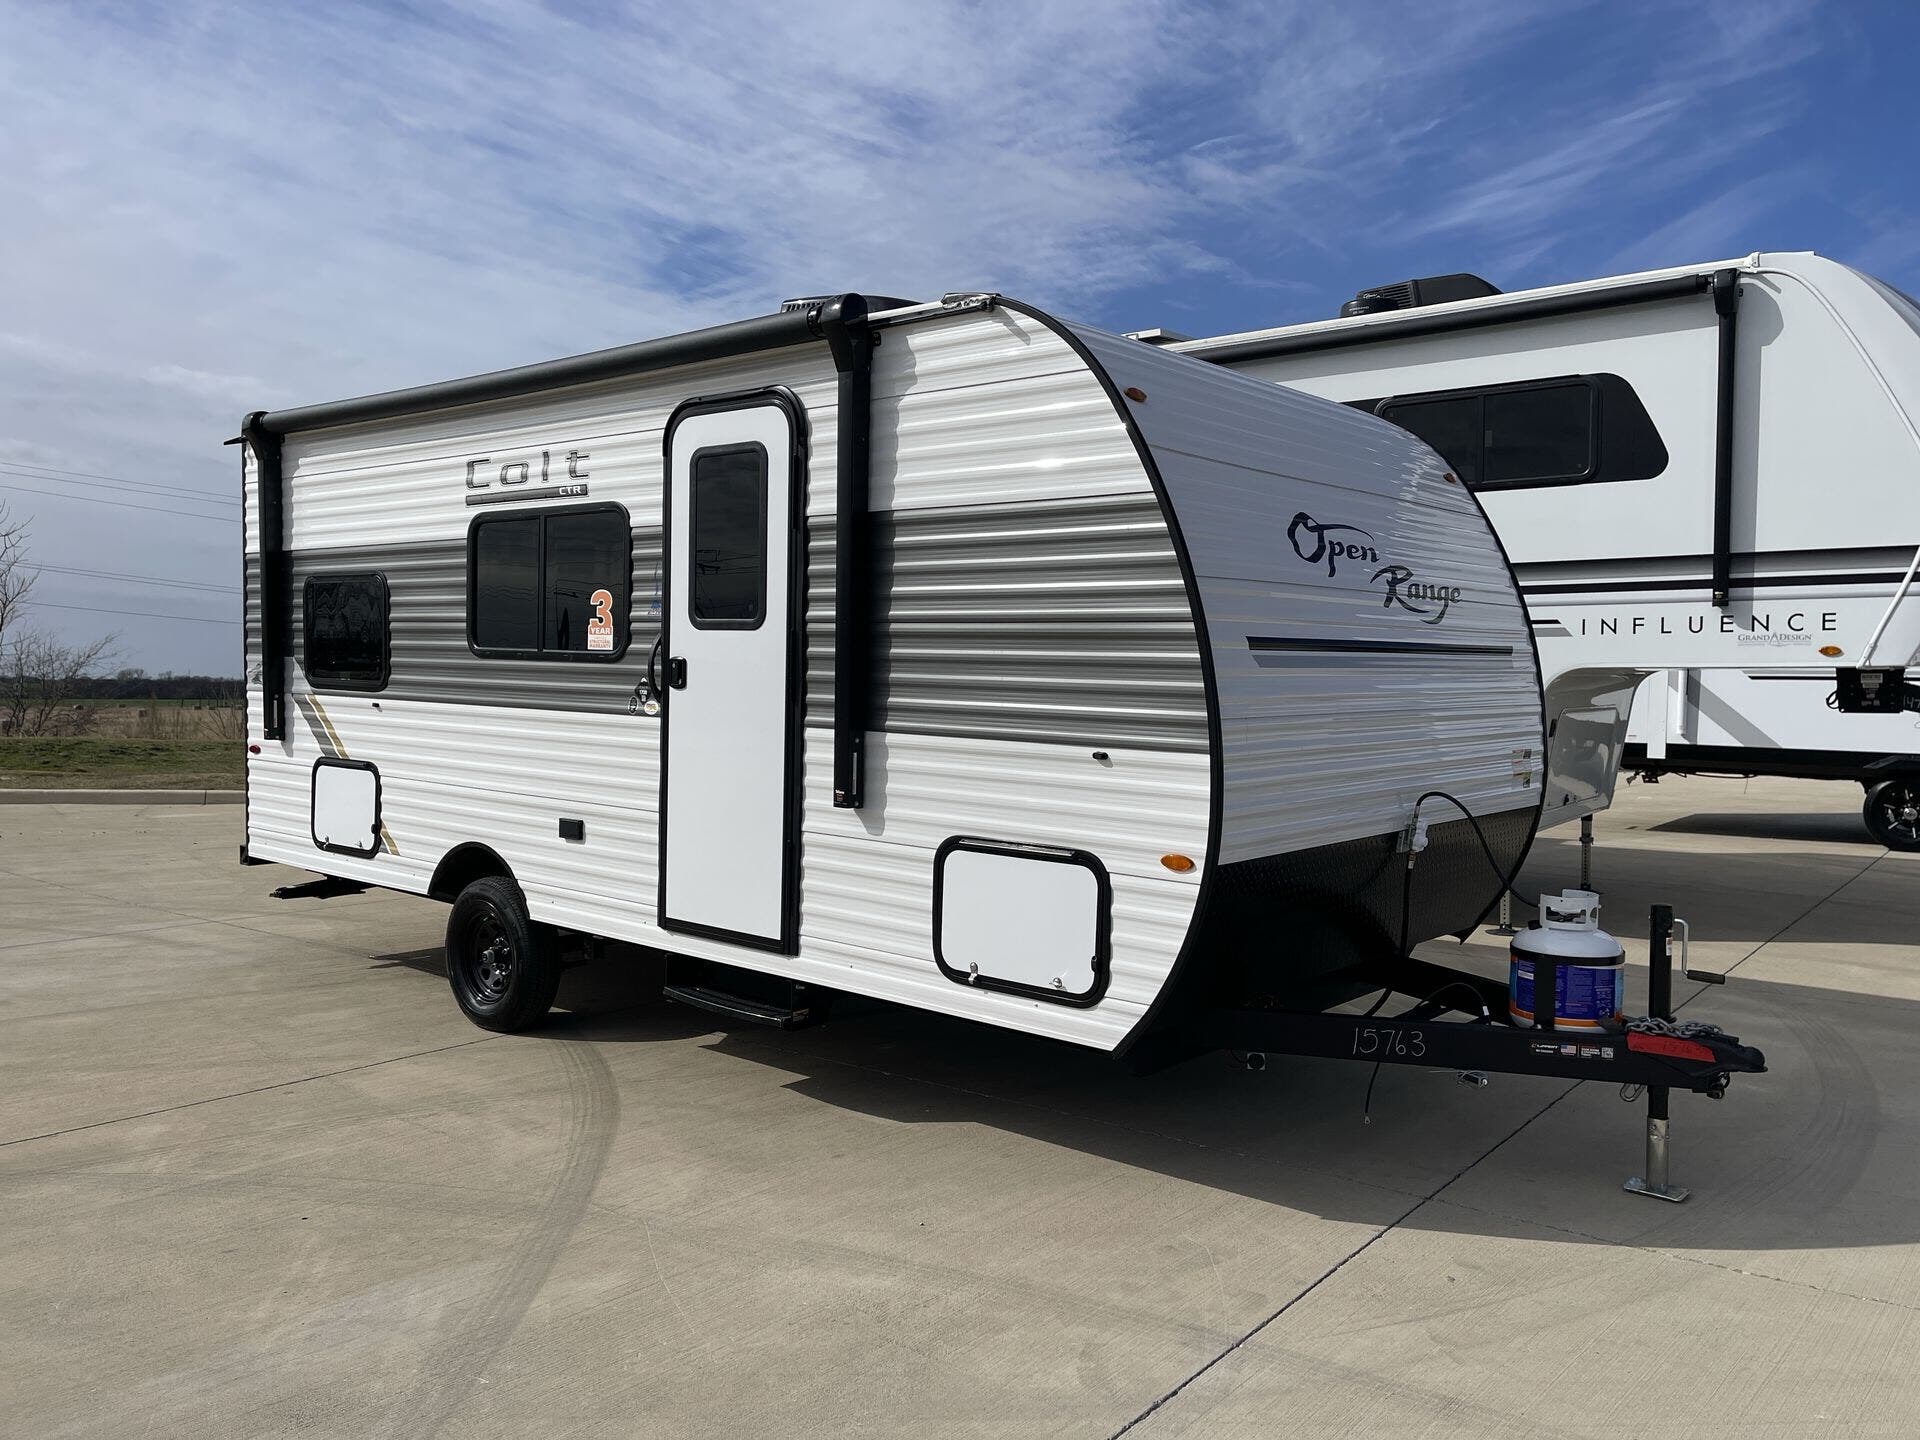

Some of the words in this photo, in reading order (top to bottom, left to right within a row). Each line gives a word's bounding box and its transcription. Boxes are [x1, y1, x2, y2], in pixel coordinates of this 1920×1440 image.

[466, 451, 589, 488] Colt
[559, 486, 581, 495] CTR
[1287, 511, 1380, 578] Open
[590, 589, 613, 626] 3
[1369, 564, 1463, 625] Range
[1582, 612, 1837, 636] INFLUENCE
[1352, 1026, 1426, 1057] 15763
